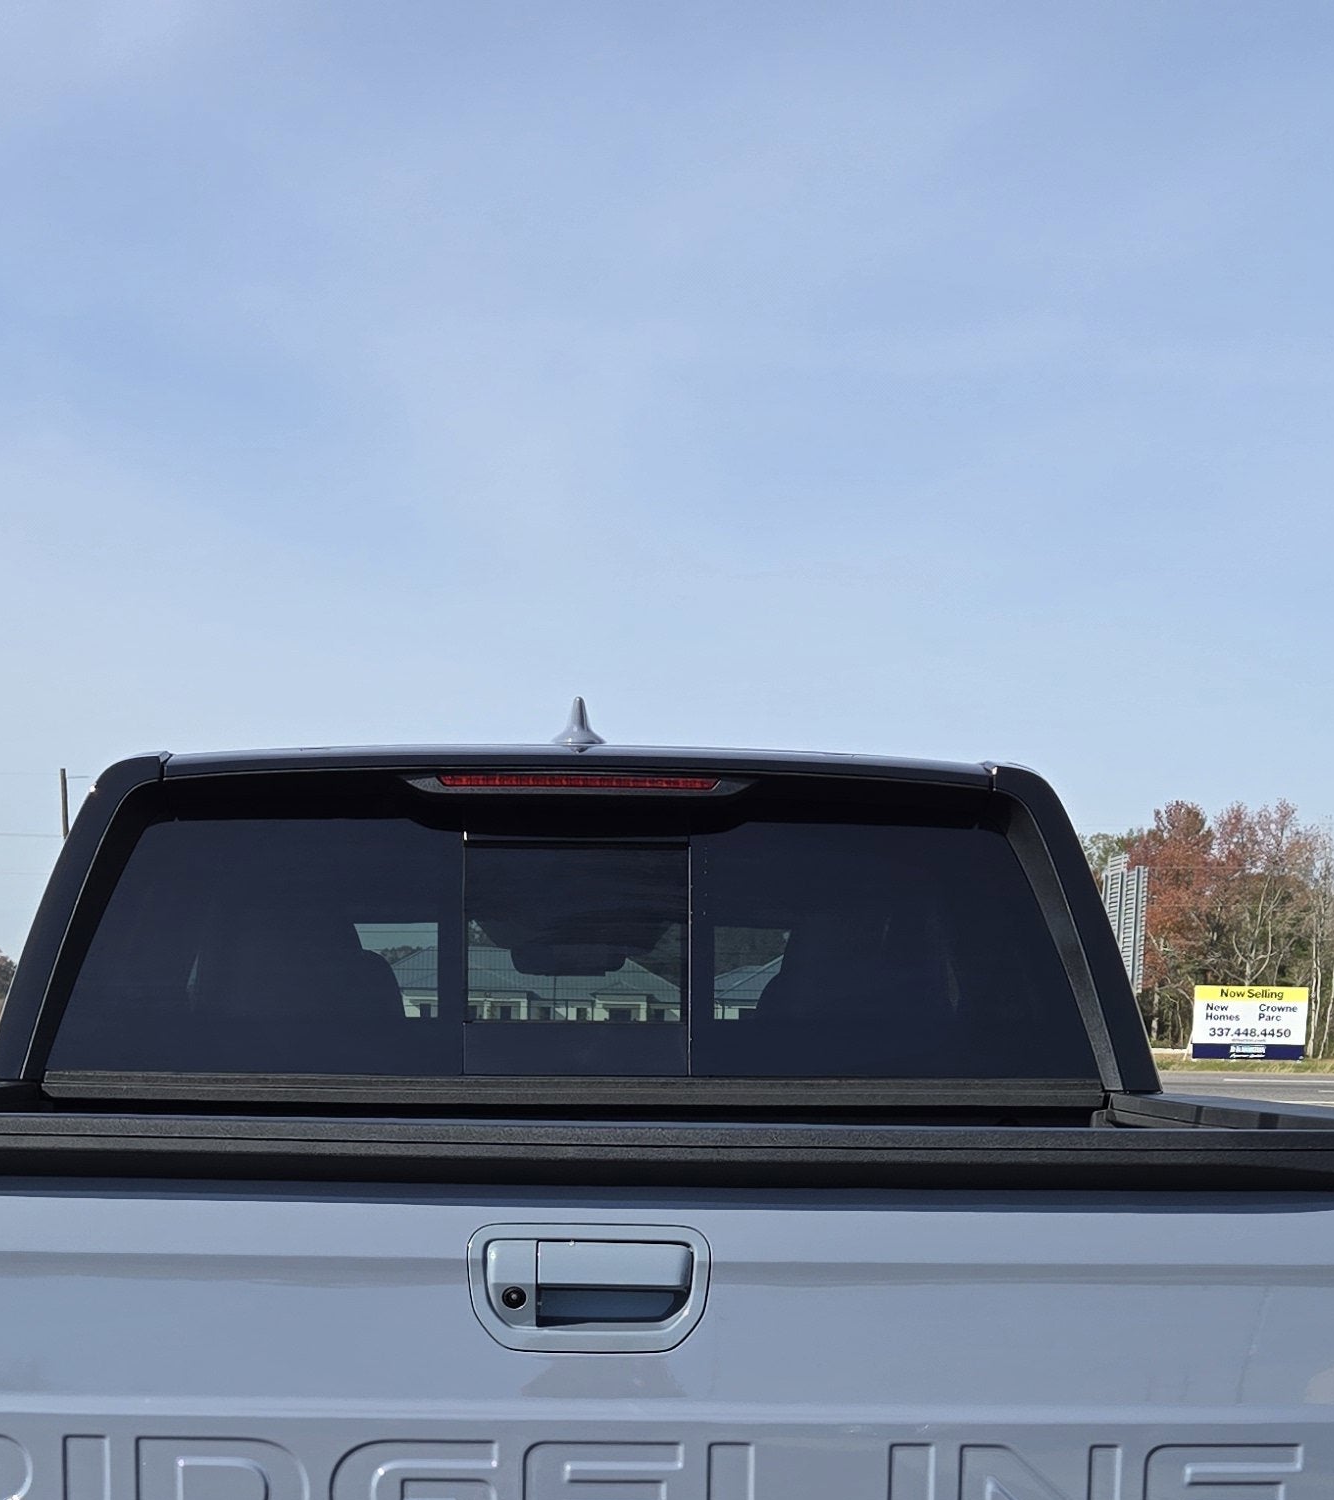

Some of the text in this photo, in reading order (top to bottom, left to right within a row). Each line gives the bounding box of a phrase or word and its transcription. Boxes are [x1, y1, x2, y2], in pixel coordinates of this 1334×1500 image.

[1220, 988, 1284, 1000] Now Selling
[1206, 1003, 1229, 1011] New
[1259, 1003, 1298, 1013] Crowne
[1205, 1012, 1241, 1021] Homes
[1258, 1013, 1282, 1022] Parc
[1209, 1027, 1291, 1038] 337.448.4450
